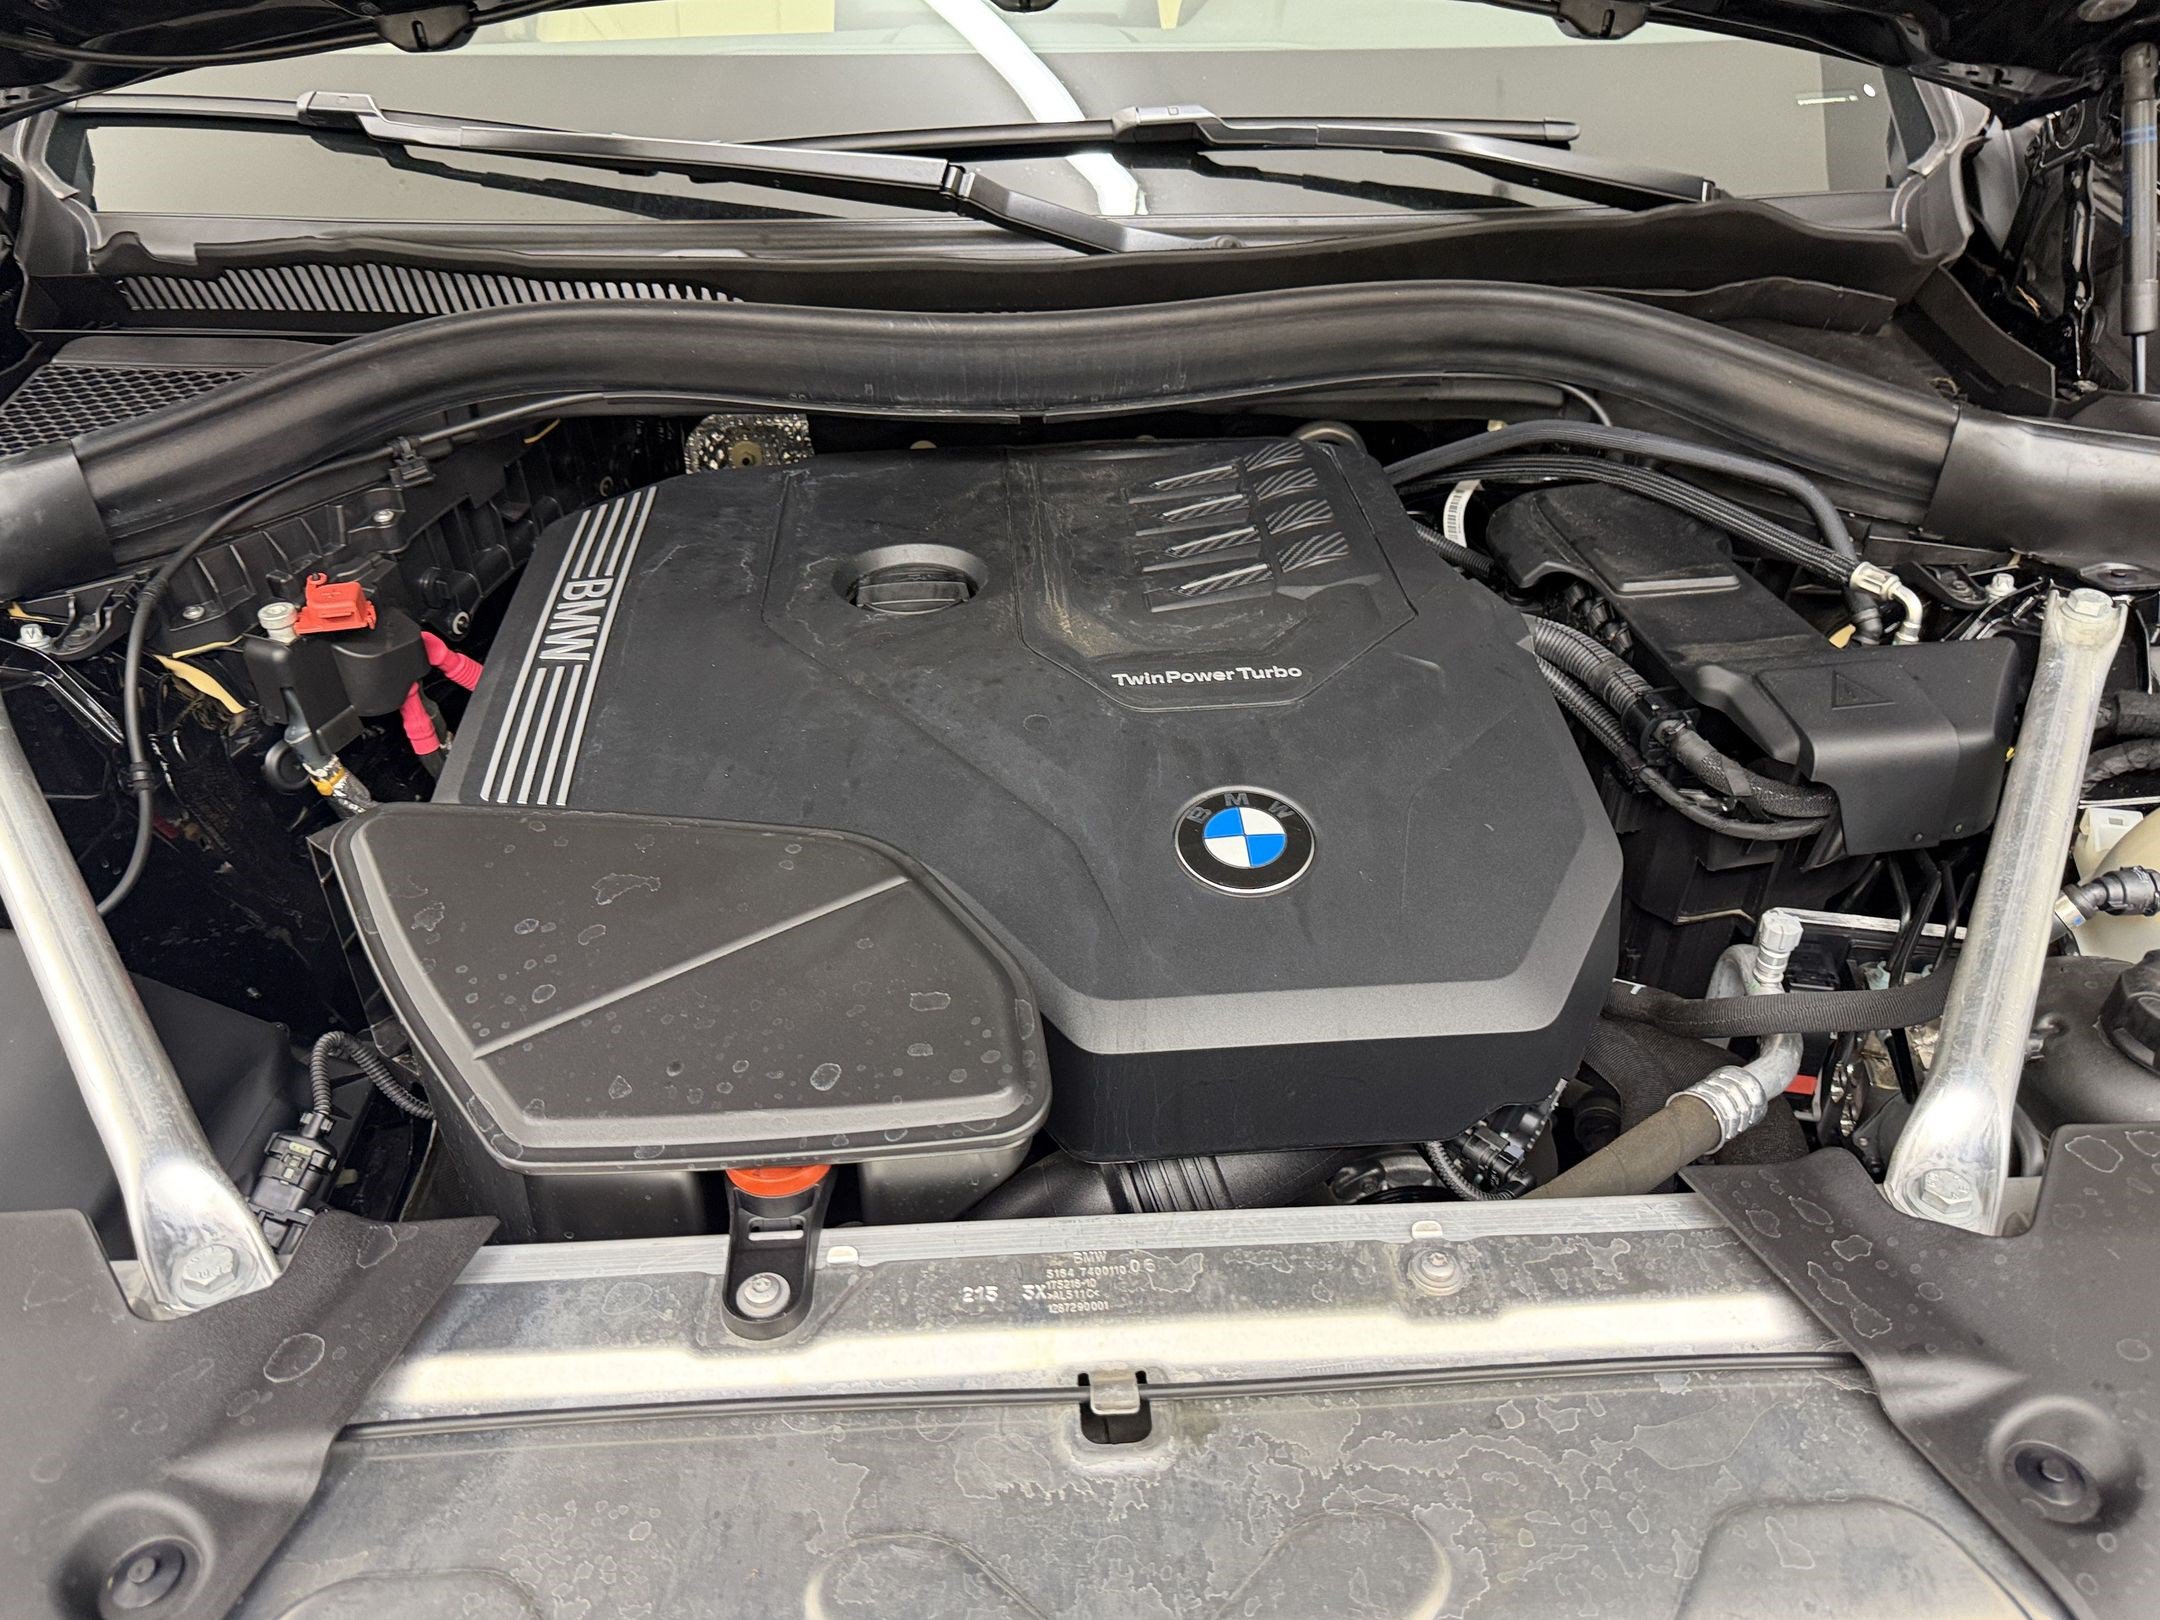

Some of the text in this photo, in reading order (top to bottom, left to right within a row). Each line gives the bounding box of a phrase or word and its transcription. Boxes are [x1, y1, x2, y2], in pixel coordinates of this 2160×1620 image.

[539, 578, 614, 660] BMW
[1112, 665, 1303, 687] TwinPower Turbo
[1187, 792, 1295, 824] BMW
[1073, 1251, 1107, 1265] BMW
